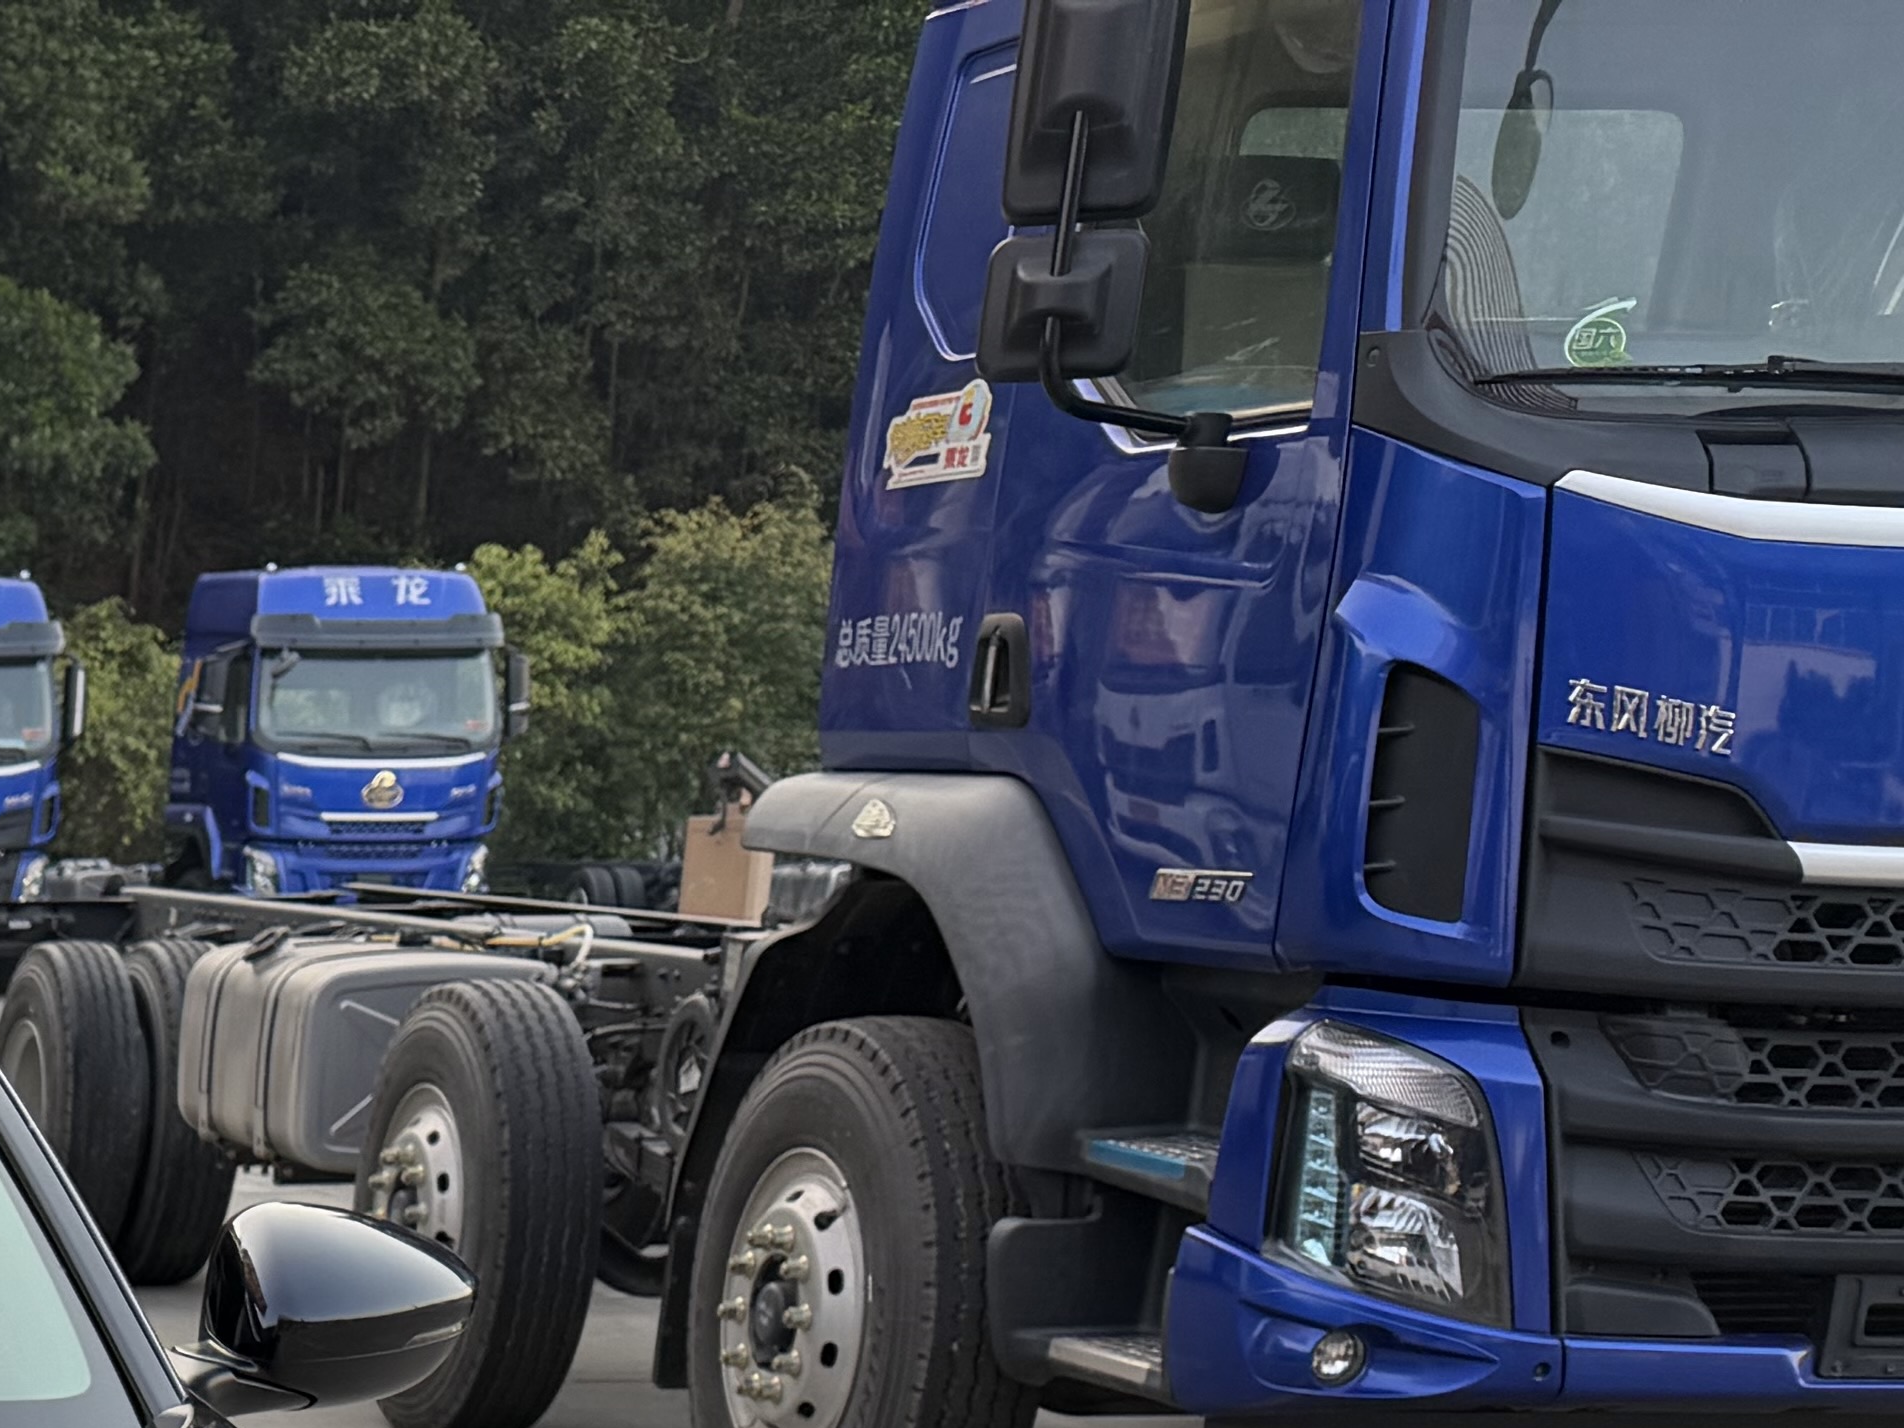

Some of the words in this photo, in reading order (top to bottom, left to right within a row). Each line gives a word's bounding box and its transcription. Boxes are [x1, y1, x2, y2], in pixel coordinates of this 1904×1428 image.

[835, 611, 963, 668] 总质量24500kg
[1567, 678, 1736, 755] 东风柳汽
[1192, 878, 1244, 901] 230
